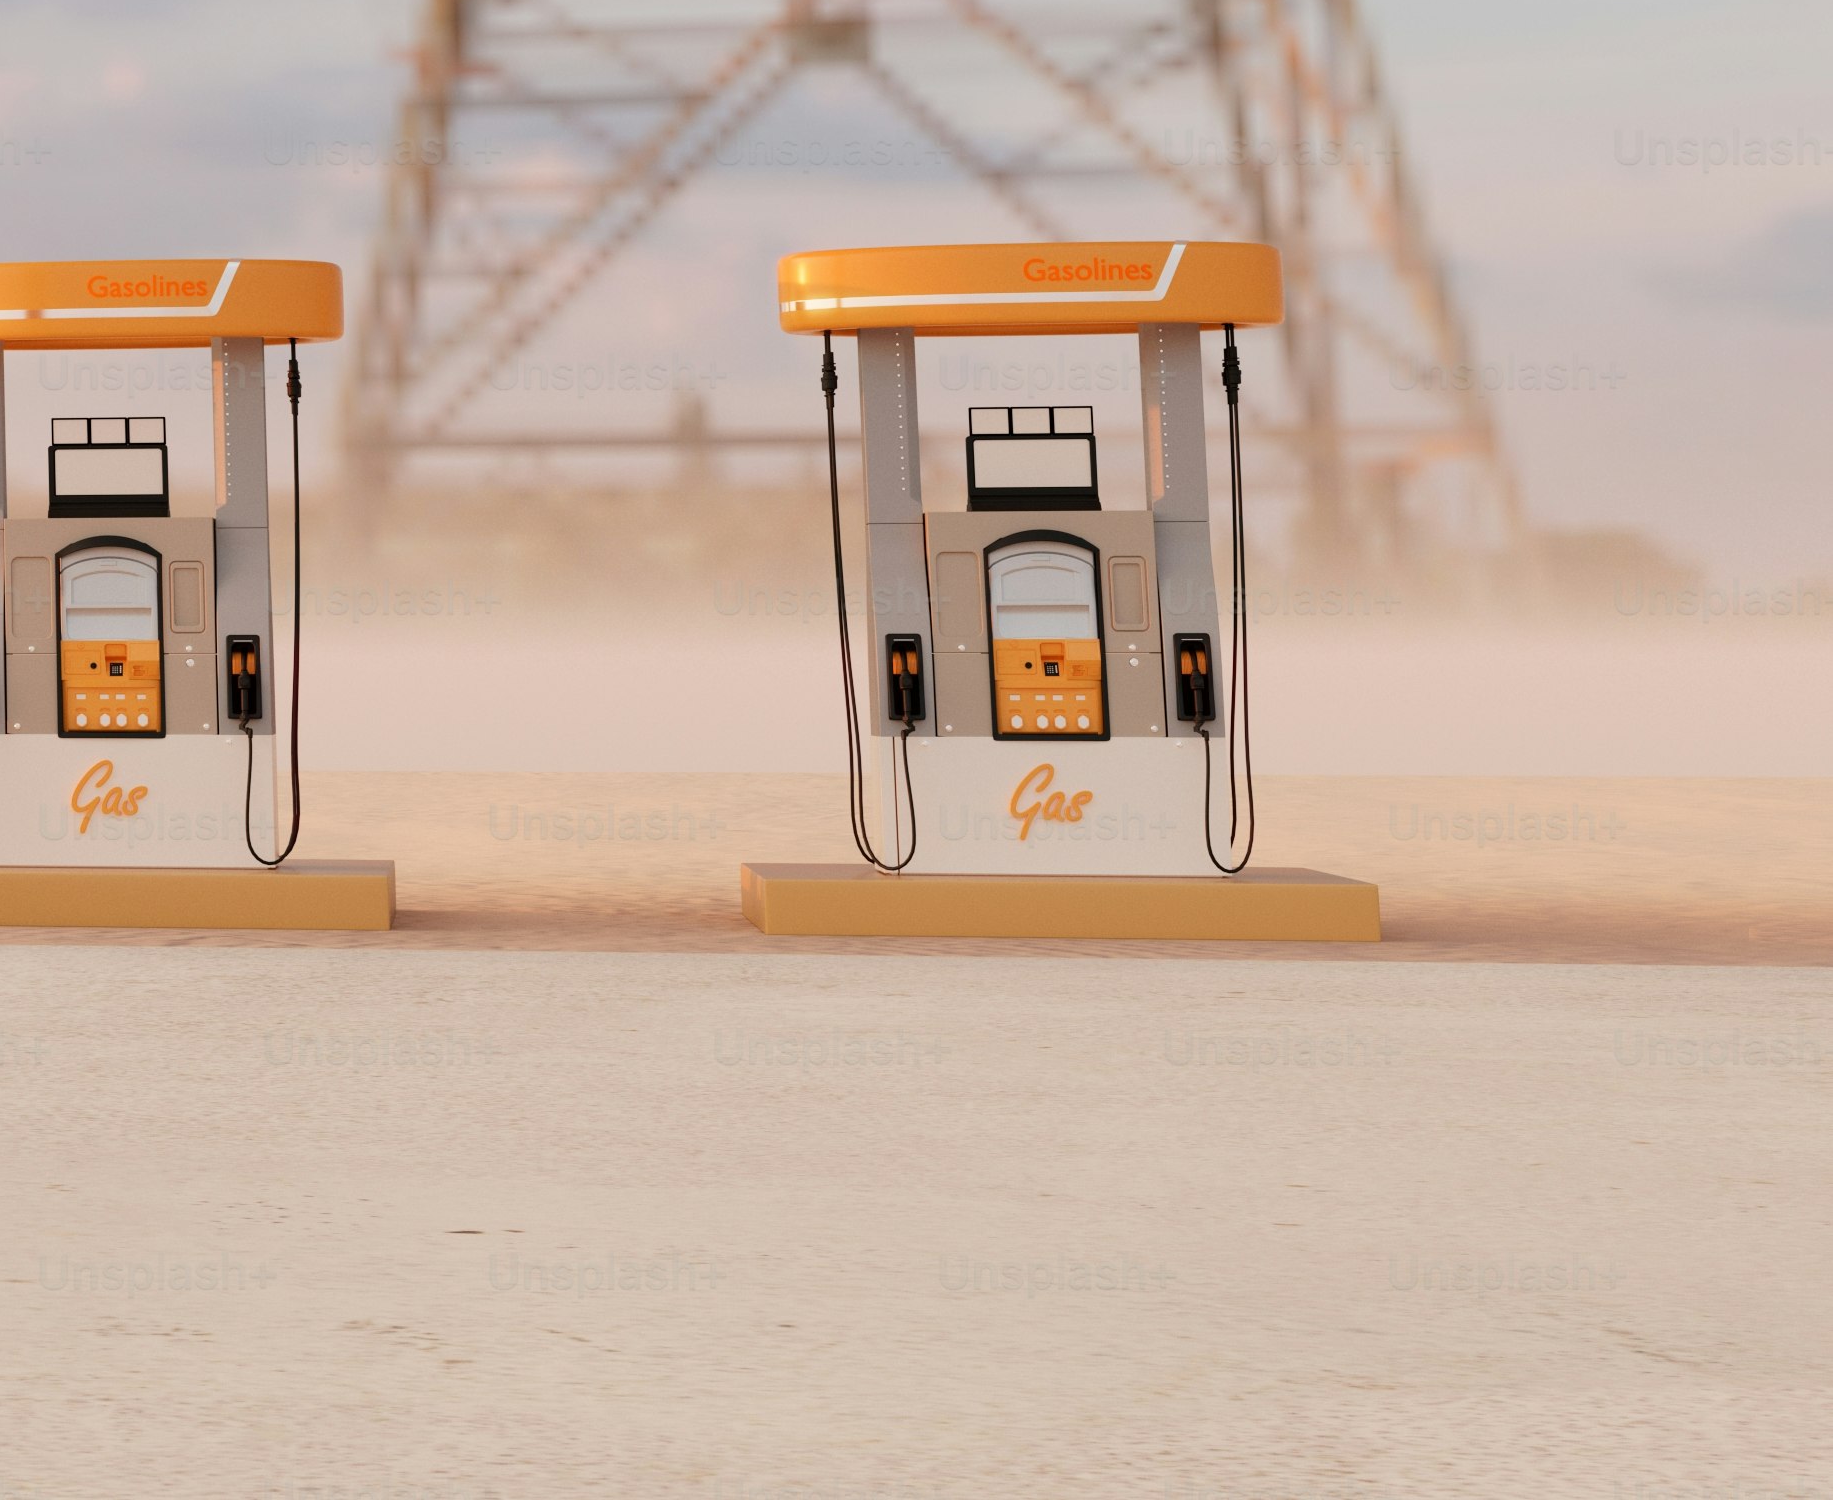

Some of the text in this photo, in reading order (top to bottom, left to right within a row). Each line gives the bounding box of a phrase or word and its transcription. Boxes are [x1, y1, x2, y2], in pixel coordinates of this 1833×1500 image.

[87, 276, 207, 298] Gasolines
[1023, 257, 1153, 283] Gasolines
[71, 760, 148, 834] Gas
[1009, 764, 1093, 840] Gas
